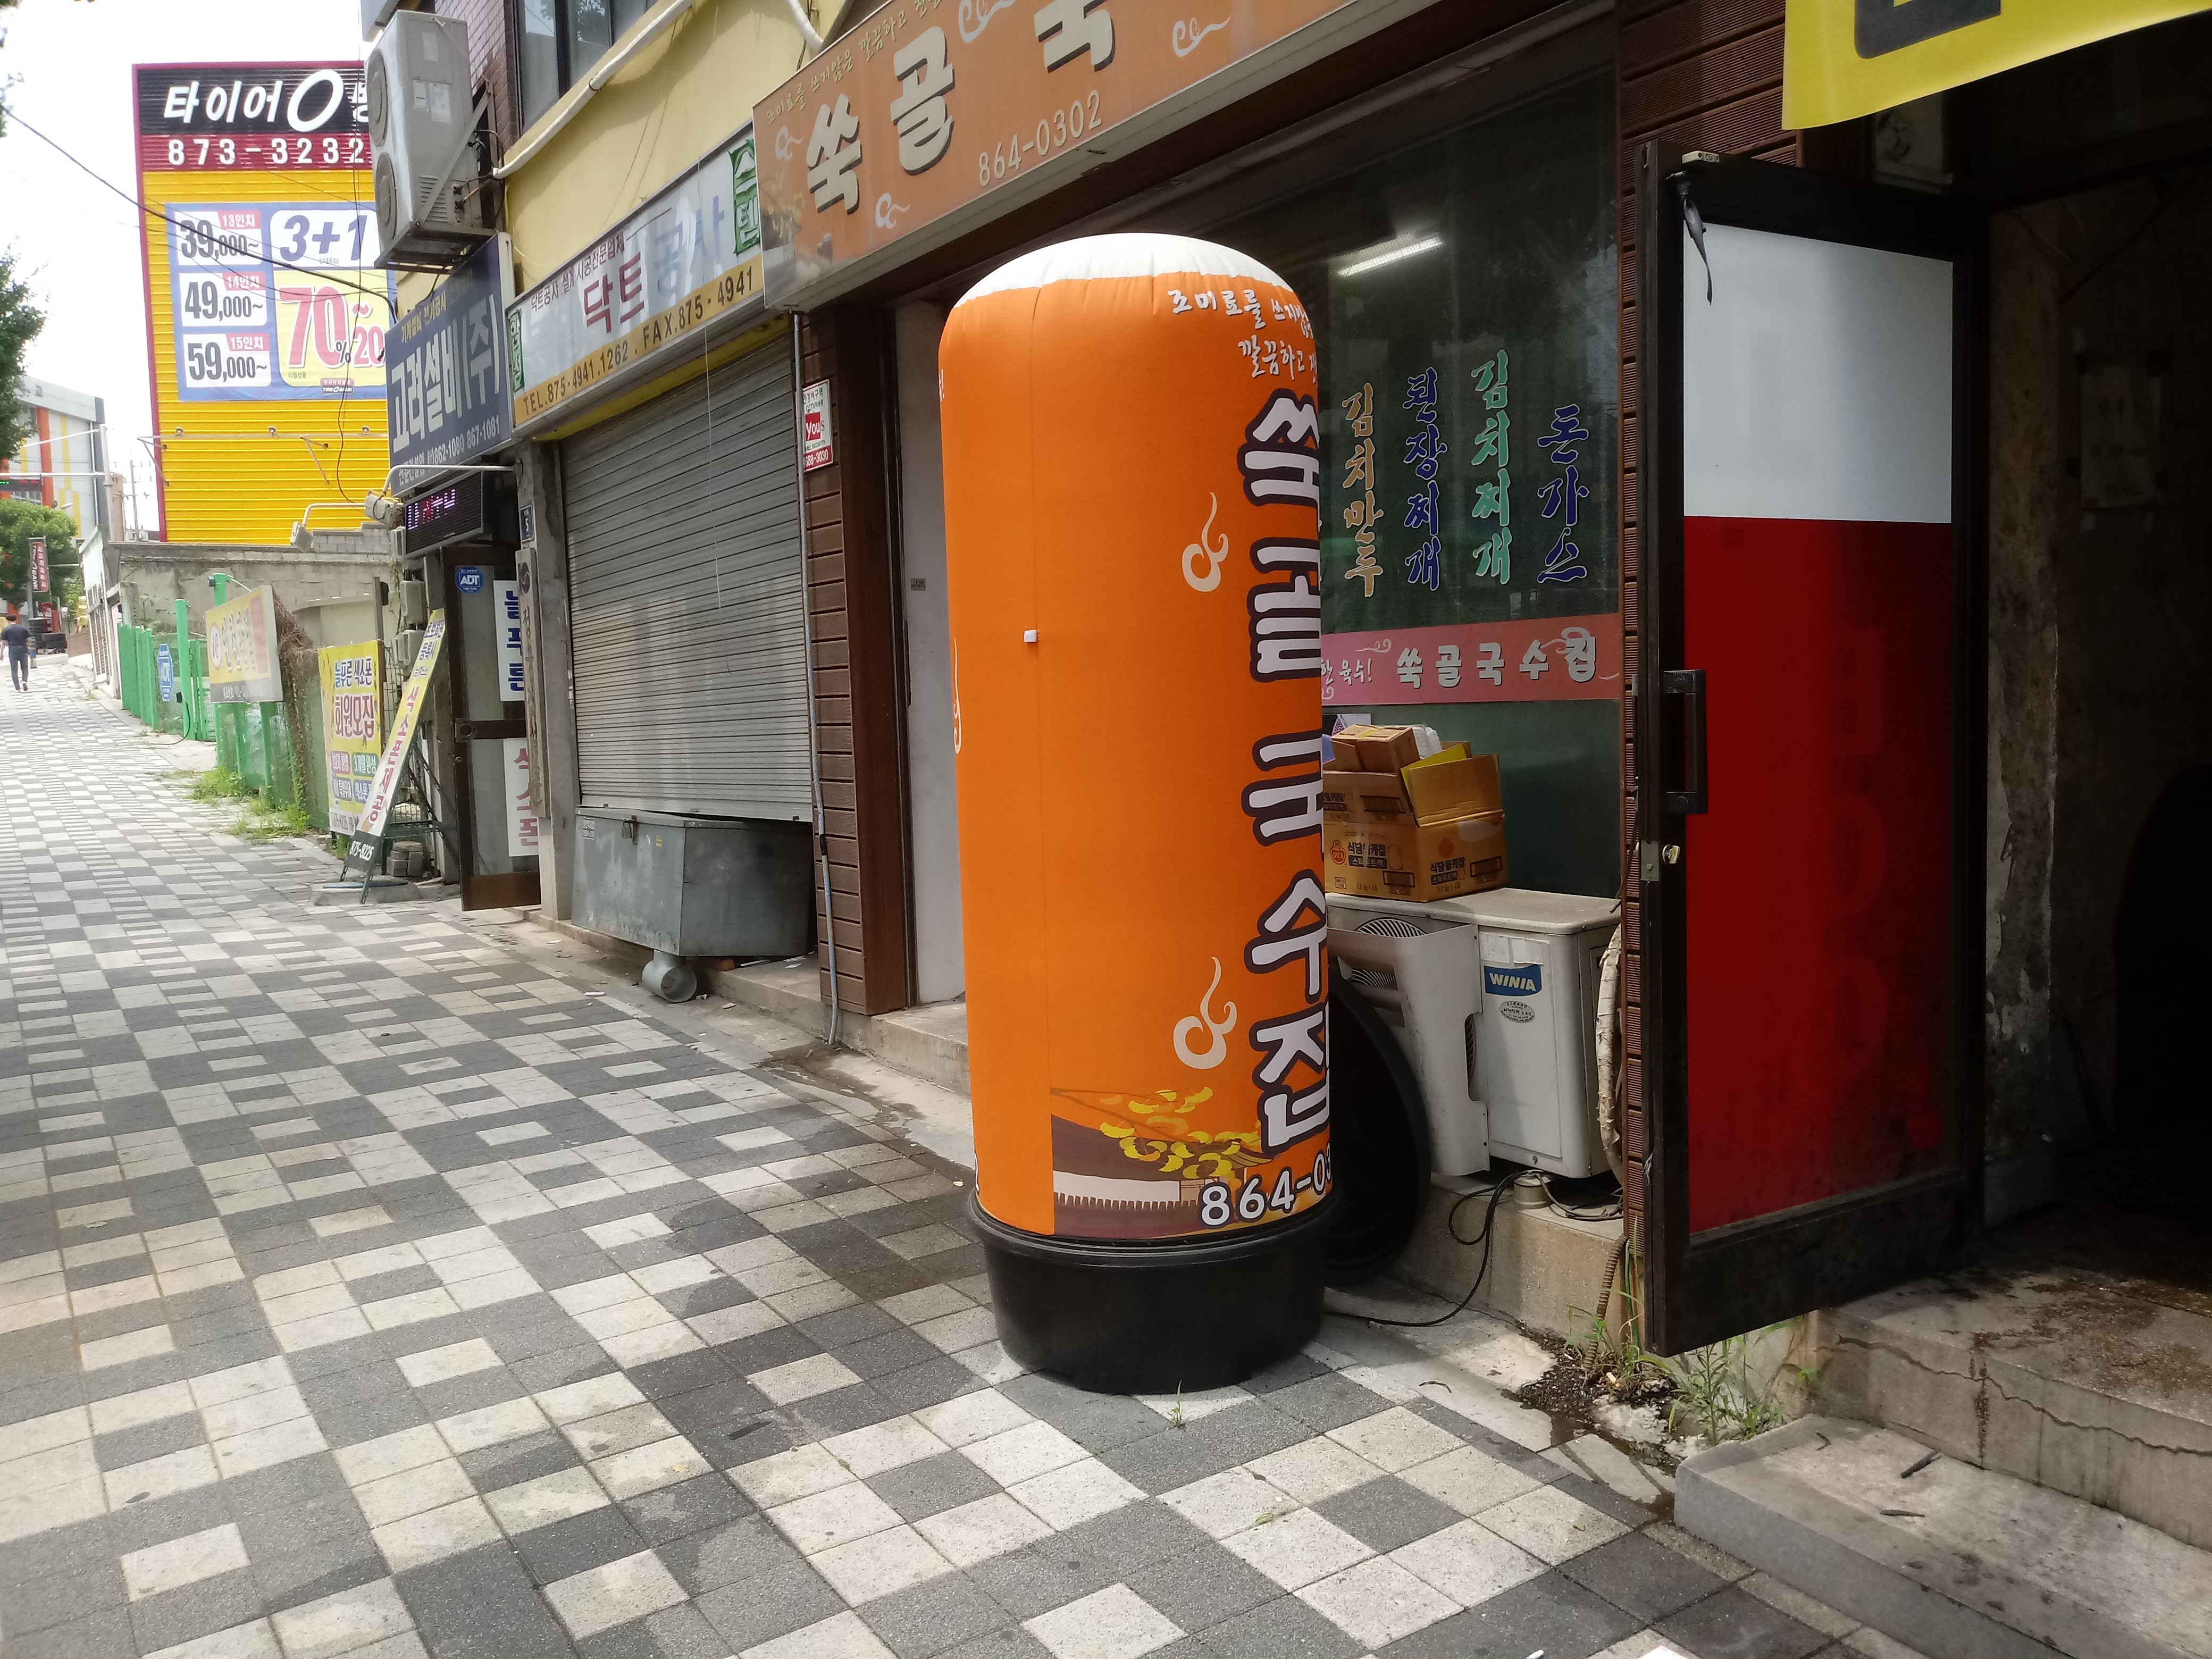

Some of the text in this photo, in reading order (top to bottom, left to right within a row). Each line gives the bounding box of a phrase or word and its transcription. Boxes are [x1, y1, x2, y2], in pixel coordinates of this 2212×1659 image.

[767, 83, 807, 124] 조미료를
[811, 49, 853, 93] 쓰지않은
[859, 10, 907, 62] 깔끔하고
[168, 137, 364, 166] 873-3232
[978, 90, 1102, 187] 864-0302
[222, 213, 255, 228] 13인치
[280, 214, 368, 262] 3+1
[226, 274, 260, 290] 14인치
[583, 252, 645, 334] 닥트
[1168, 289, 1267, 330] 조미료를
[230, 337, 263, 350] 15인치
[1238, 333, 1305, 381] 깔끔하고
[466, 414, 500, 450] 867-1081
[1402, 366, 1448, 591] 된장찌개
[1471, 349, 1512, 585] 김치찌개
[1342, 382, 1384, 598] 김치만두
[1537, 404, 1590, 583] 돈가스
[460, 574, 480, 585] ADT
[334, 658, 373, 688] 늘푸른 색소폰
[1339, 658, 1372, 686] 육수!
[1396, 627, 1597, 687] 쑥골국수집
[334, 694, 375, 739] 회원모집
[349, 840, 375, 862] 875-8225
[1488, 972, 1537, 992] WINIA
